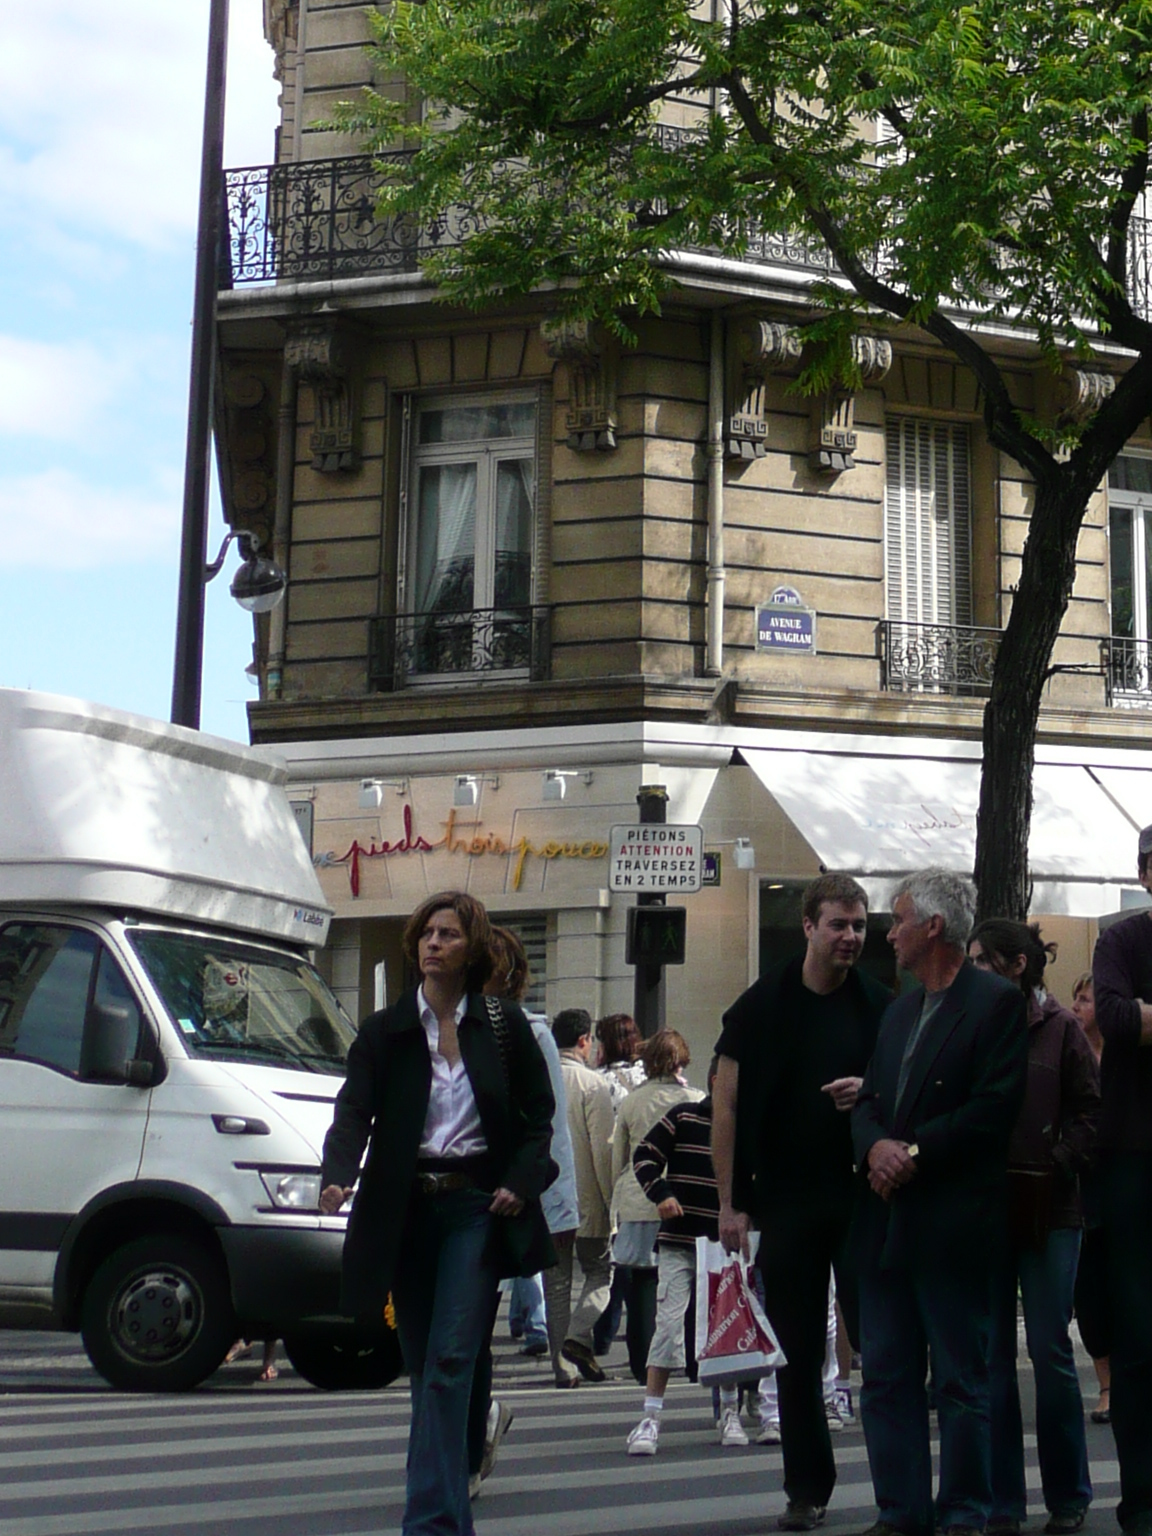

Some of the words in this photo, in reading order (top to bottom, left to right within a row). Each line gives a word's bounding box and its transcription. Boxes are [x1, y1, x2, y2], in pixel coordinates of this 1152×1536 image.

[769, 617, 802, 629] AVENUE
[759, 630, 772, 641] DE
[774, 631, 812, 644] WAGRAM
[627, 828, 686, 842] PIÉTONS
[620, 845, 693, 856] ATTENTION
[616, 860, 696, 872] TRAVERSEZ
[615, 875, 631, 886] EN
[637, 875, 645, 886] 2
[651, 875, 696, 886] TEMPS
